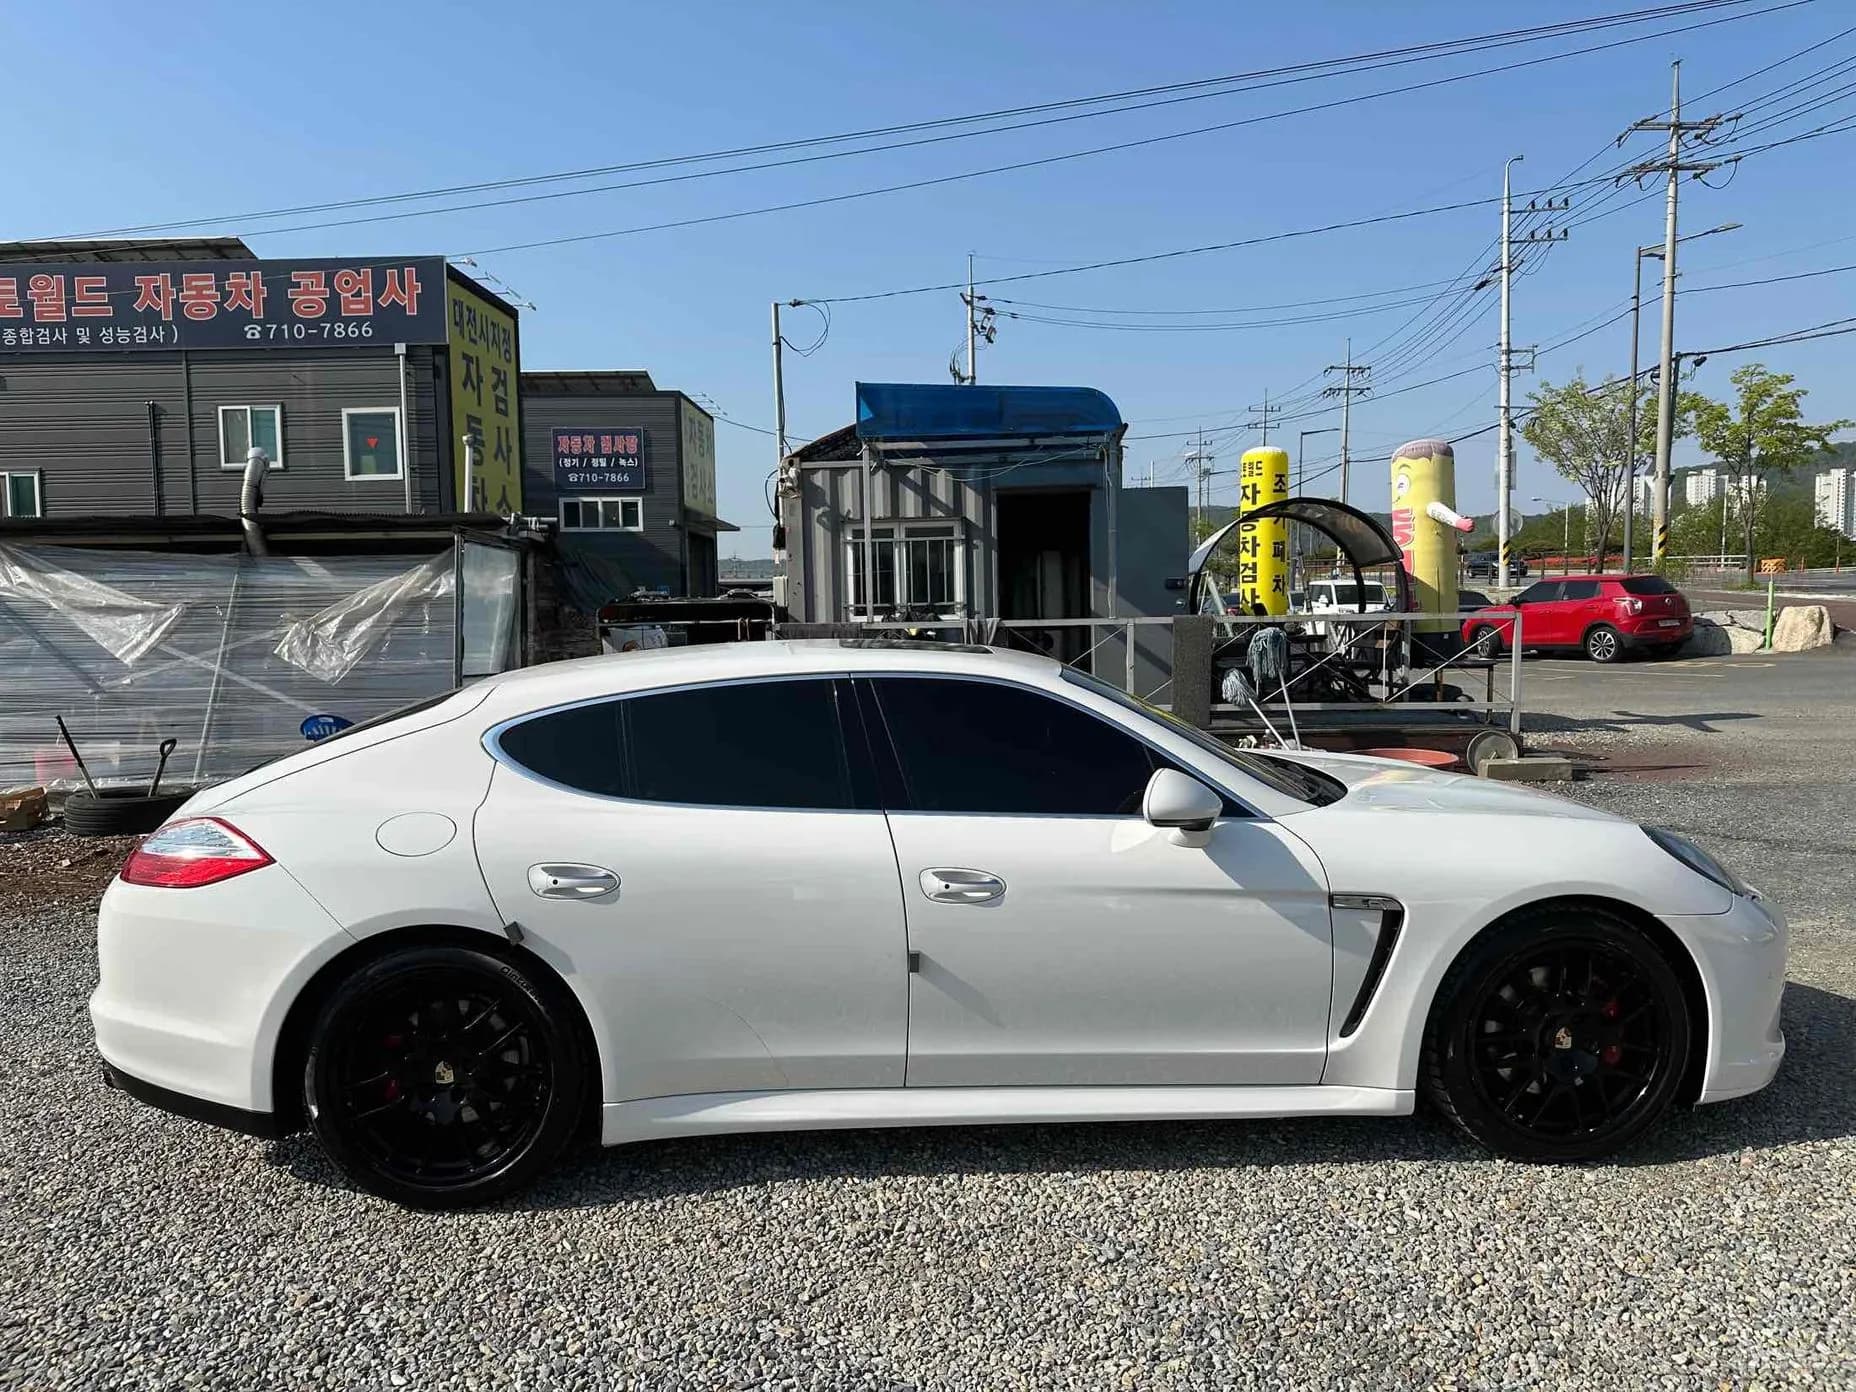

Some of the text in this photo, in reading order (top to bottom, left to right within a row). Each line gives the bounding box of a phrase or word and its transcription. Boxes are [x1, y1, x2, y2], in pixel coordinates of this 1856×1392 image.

[133, 271, 268, 321] 자동차
[287, 267, 422, 319] 공업사
[1, 326, 68, 346] 종합검사
[76, 326, 91, 345] 및
[265, 321, 374, 340] 710-7866
[452, 297, 513, 365] 대전시지정
[557, 434, 596, 455] 자동차
[578, 472, 630, 483] 710-7866
